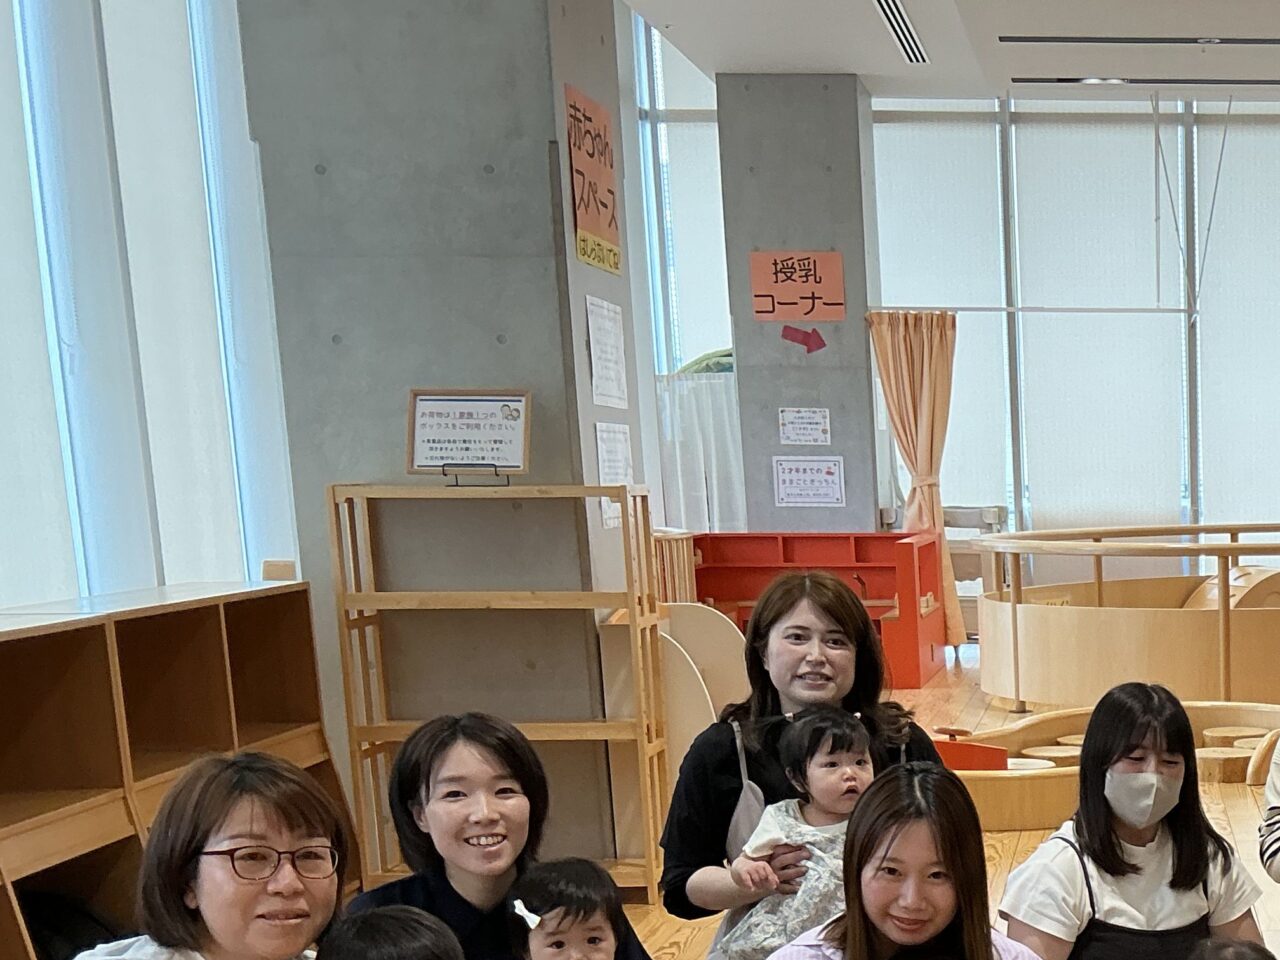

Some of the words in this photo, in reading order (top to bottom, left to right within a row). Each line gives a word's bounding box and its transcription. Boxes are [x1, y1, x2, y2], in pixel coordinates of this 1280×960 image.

[569, 101, 613, 169] 赤ちゃん
[575, 168, 618, 231] スペース
[772, 257, 822, 284] 授乳
[754, 291, 844, 316] コーナー
